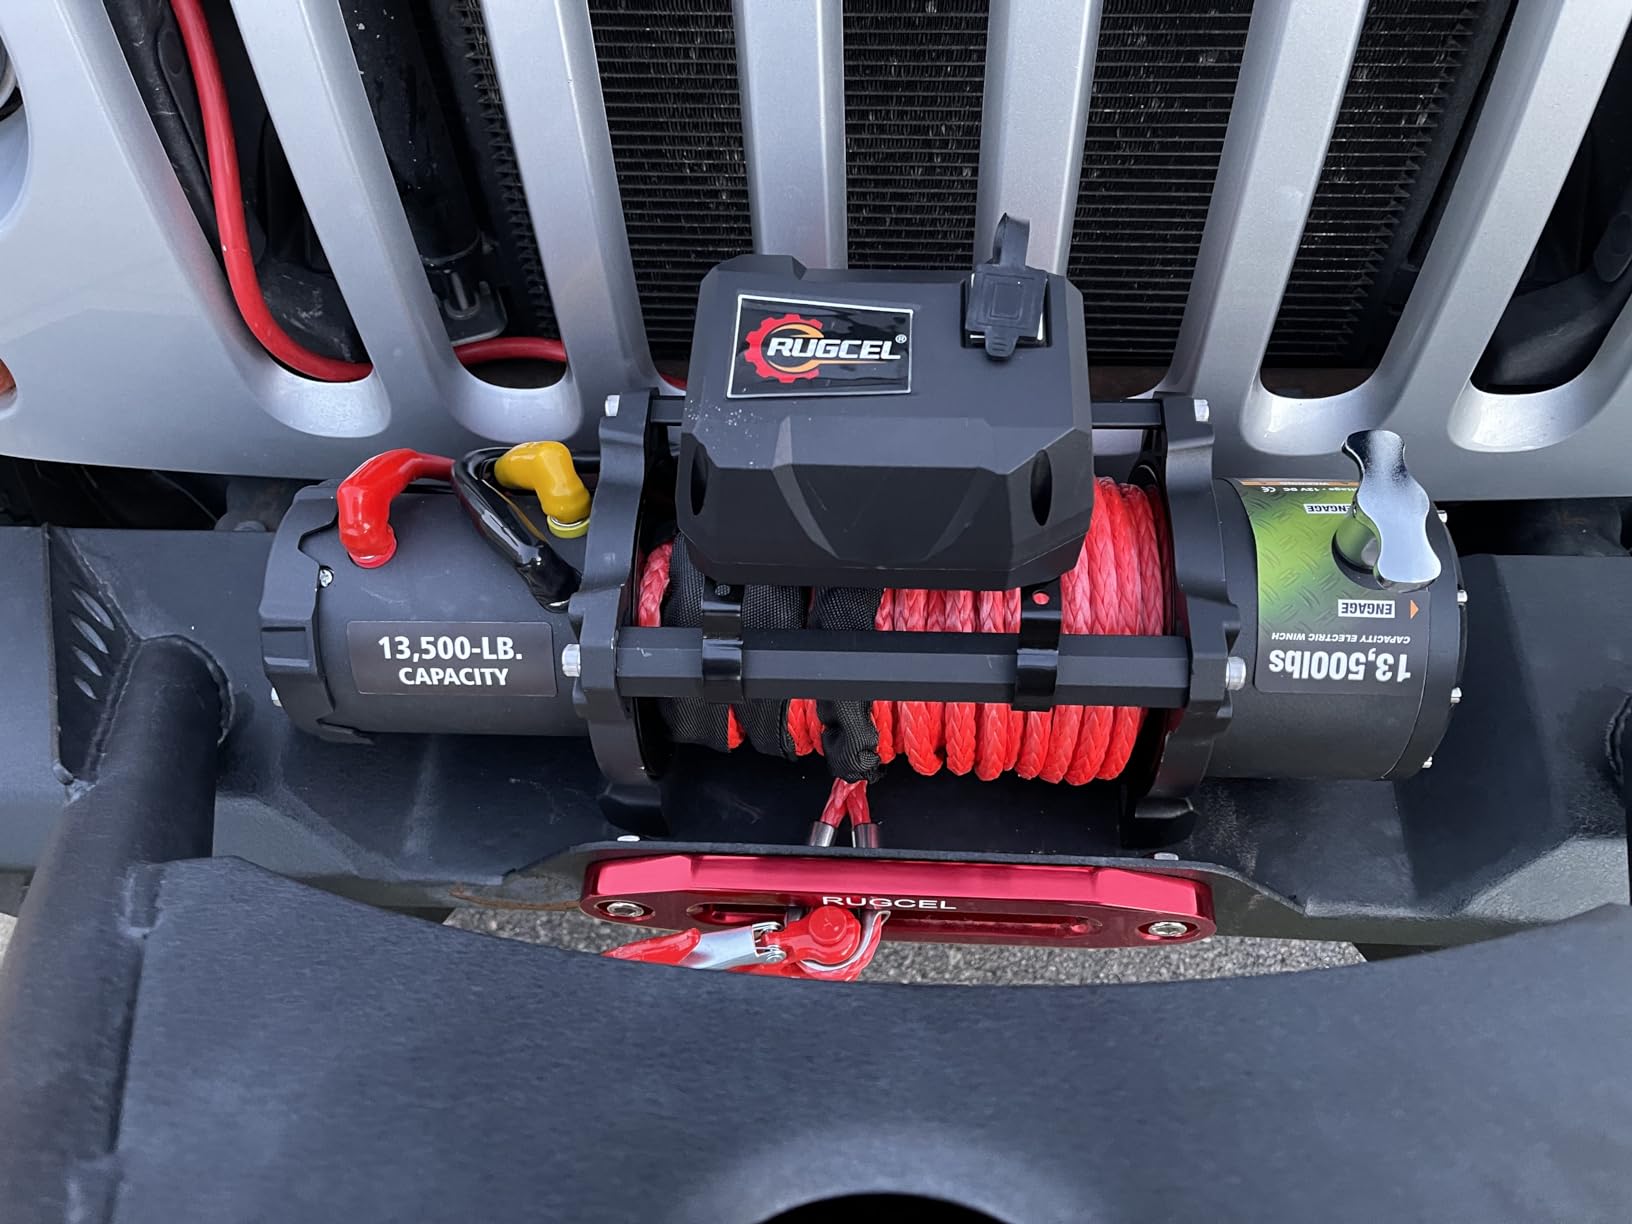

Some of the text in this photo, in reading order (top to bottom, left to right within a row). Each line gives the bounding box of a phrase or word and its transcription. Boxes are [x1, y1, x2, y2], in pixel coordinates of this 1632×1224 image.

[1341, 602, 1393, 615] ENGAGE
[1271, 632, 1411, 645] CAPACITY ELECTRIC WINCH
[378, 636, 523, 663] 13,500-LB.
[1268, 648, 1411, 683] 13,500lbs
[398, 667, 509, 686] CAPACITY
[822, 896, 957, 910] RUGCEL
